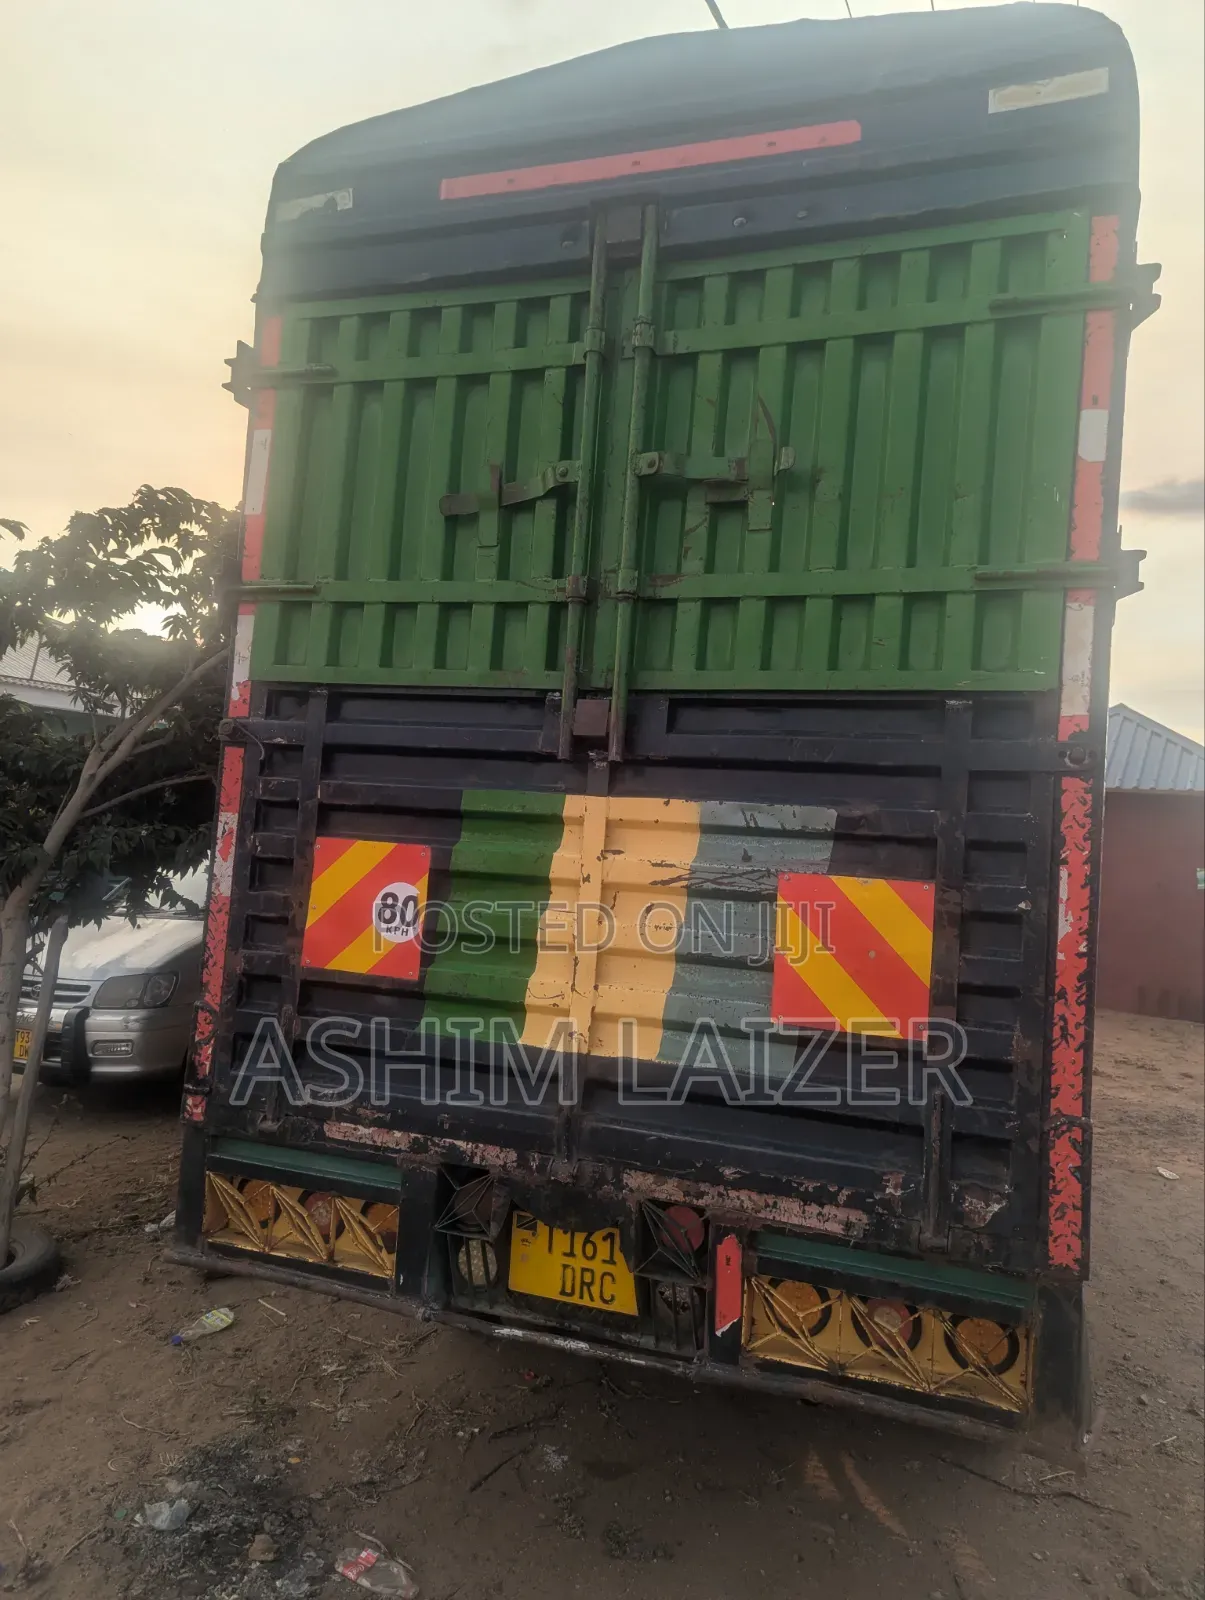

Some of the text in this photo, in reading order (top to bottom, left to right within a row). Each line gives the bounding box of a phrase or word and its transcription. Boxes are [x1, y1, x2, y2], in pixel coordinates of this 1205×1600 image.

[378, 892, 418, 927] 80
[386, 925, 409, 937] KPH
[559, 1264, 616, 1305] DRC
